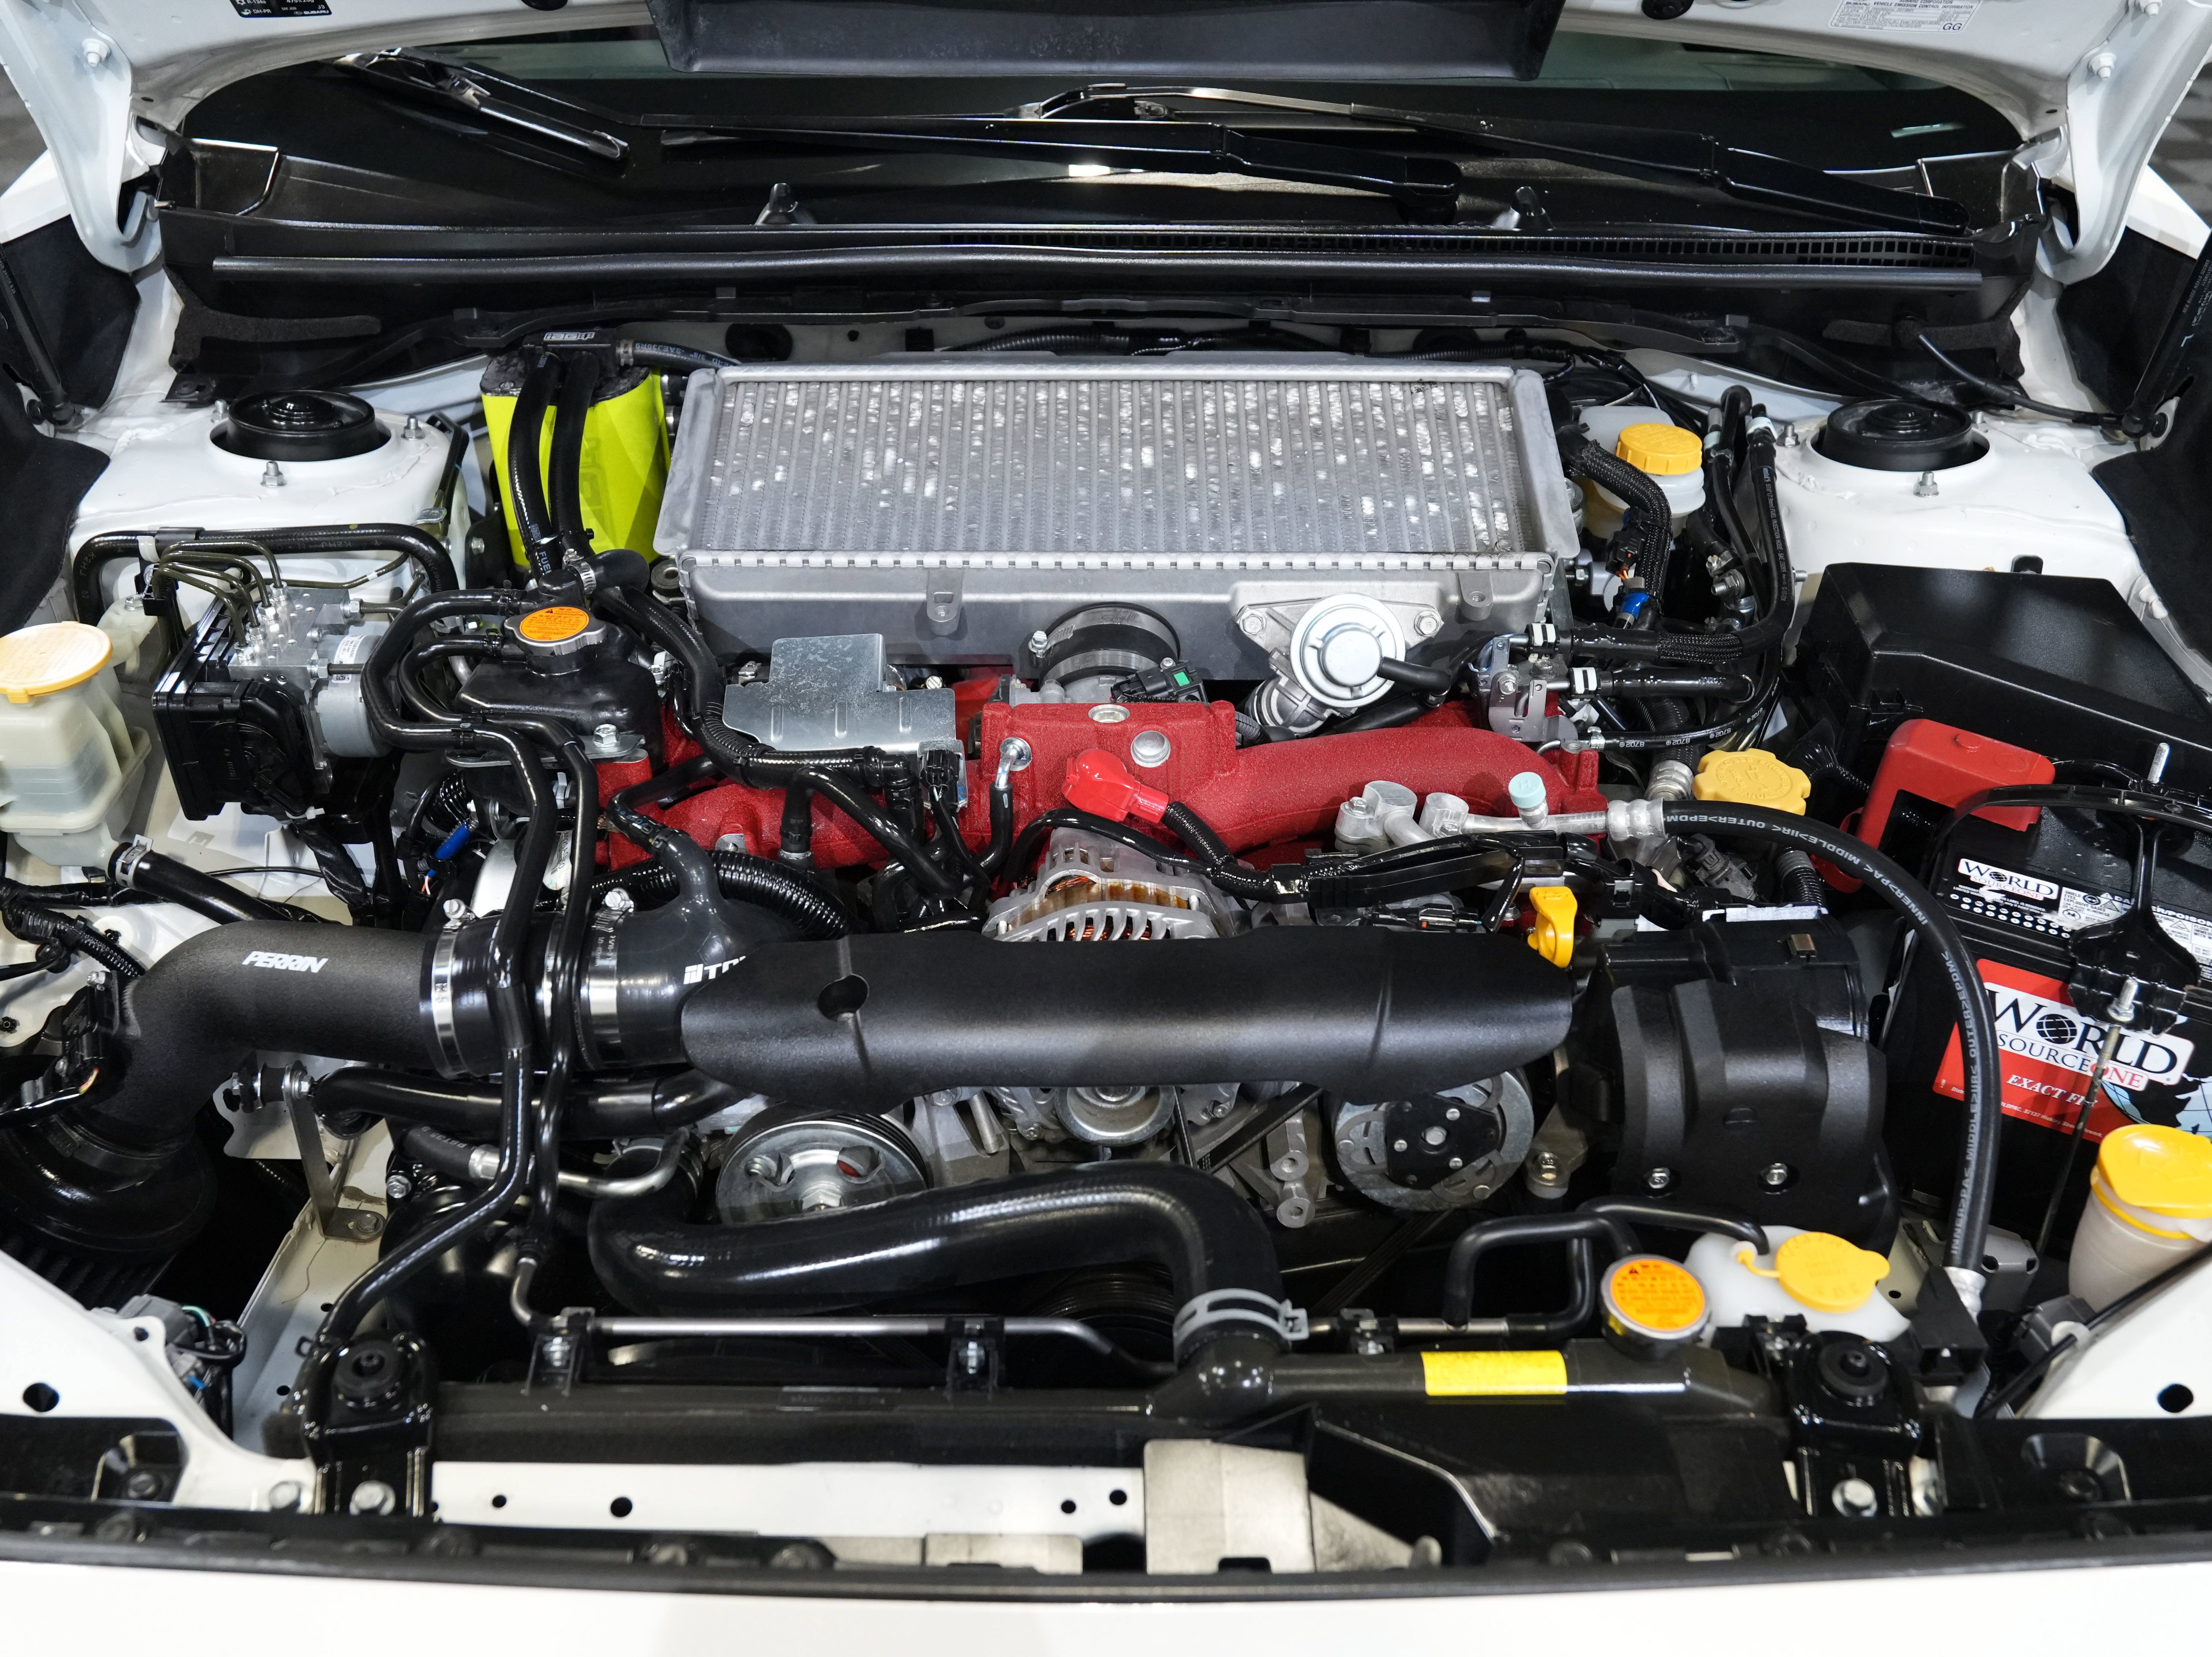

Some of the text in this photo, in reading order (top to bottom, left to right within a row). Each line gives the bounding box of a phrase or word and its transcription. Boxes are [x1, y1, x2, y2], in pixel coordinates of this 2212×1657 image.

[1751, 707, 1763, 721] 8702
[1715, 727, 1732, 738] 8702
[1663, 815, 1766, 829] OUTER>EPDM
[1964, 861, 2054, 895] WORLD
[1971, 876, 2041, 900] SOURCEONE
[2064, 898, 2089, 909] EXPLOSIVE
[242, 950, 329, 973] PERRIN
[1986, 988, 2178, 1074] WORLD
[1997, 1033, 2144, 1088] SOURCEONE
[2005, 1074, 2069, 1099] EXACT
[2023, 1108, 2041, 1118] 37137
[2041, 1112, 2061, 1126] Hickory
